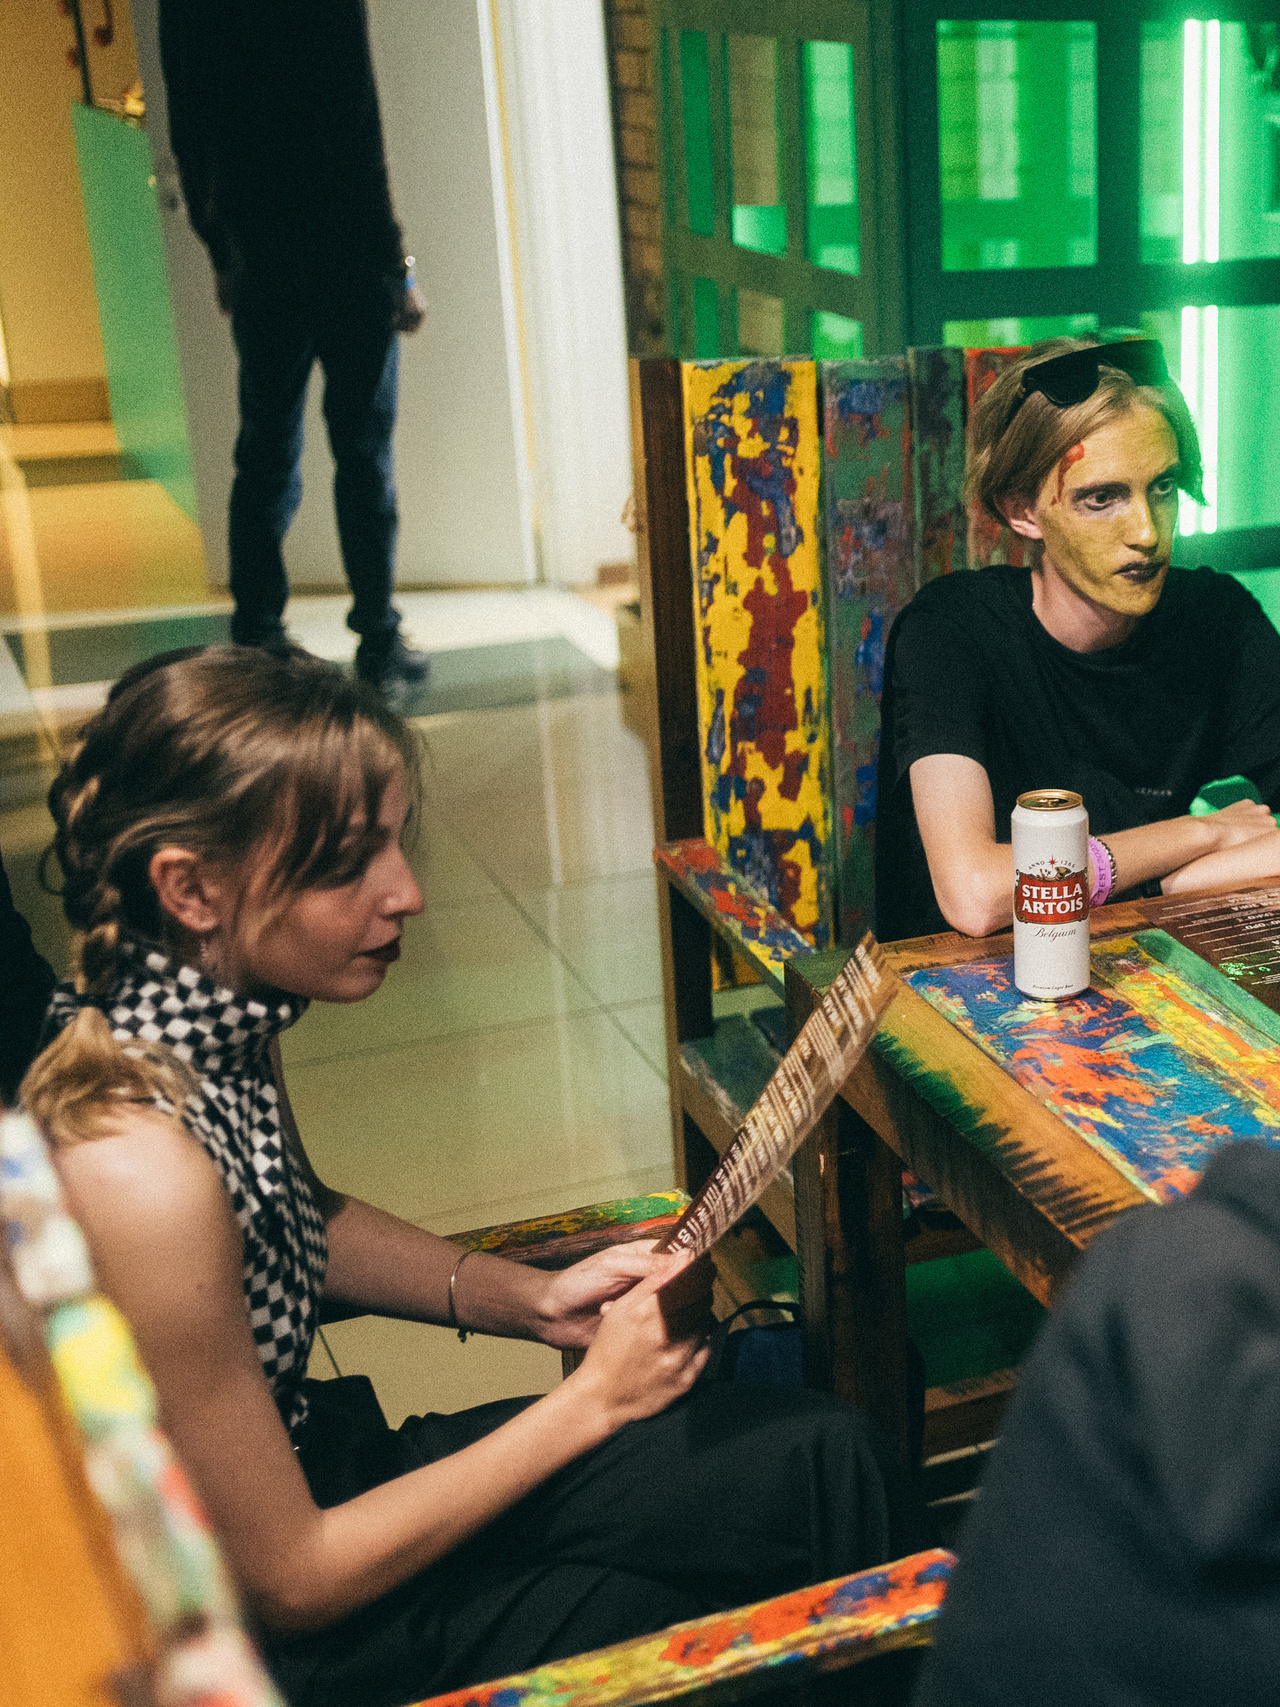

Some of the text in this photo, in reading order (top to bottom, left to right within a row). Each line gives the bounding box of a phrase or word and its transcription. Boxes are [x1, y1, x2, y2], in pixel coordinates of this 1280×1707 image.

[1022, 883, 1083, 900] STELLA
[1022, 897, 1083, 915] ARTOIS
[1032, 927, 1077, 943] Belgium
